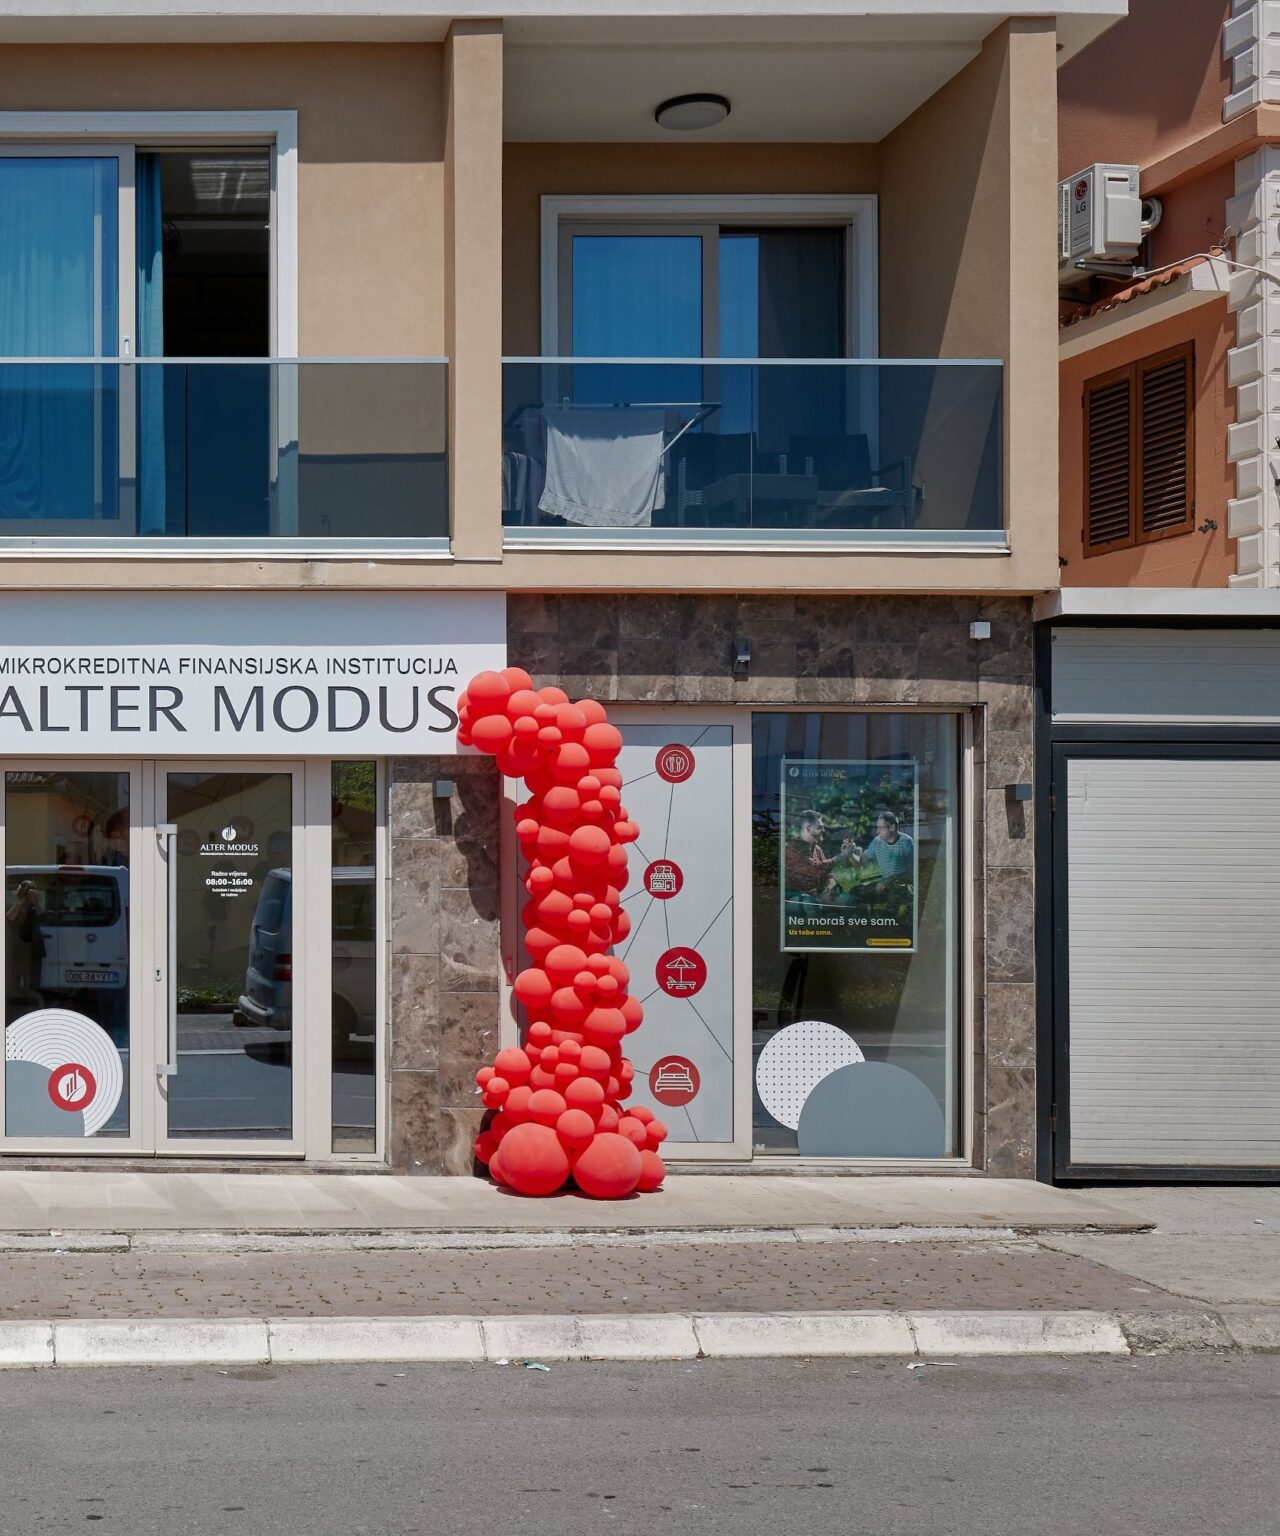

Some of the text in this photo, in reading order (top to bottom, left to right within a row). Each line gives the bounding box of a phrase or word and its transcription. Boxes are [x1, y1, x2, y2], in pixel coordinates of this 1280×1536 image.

[1076, 202, 1086, 213] LG
[180, 658, 318, 674] FINANSIJSKA
[326, 658, 458, 674] INSTITUCIJA
[213, 685, 459, 732] MODUS
[789, 915, 899, 926] Ne moraš sve sam.
